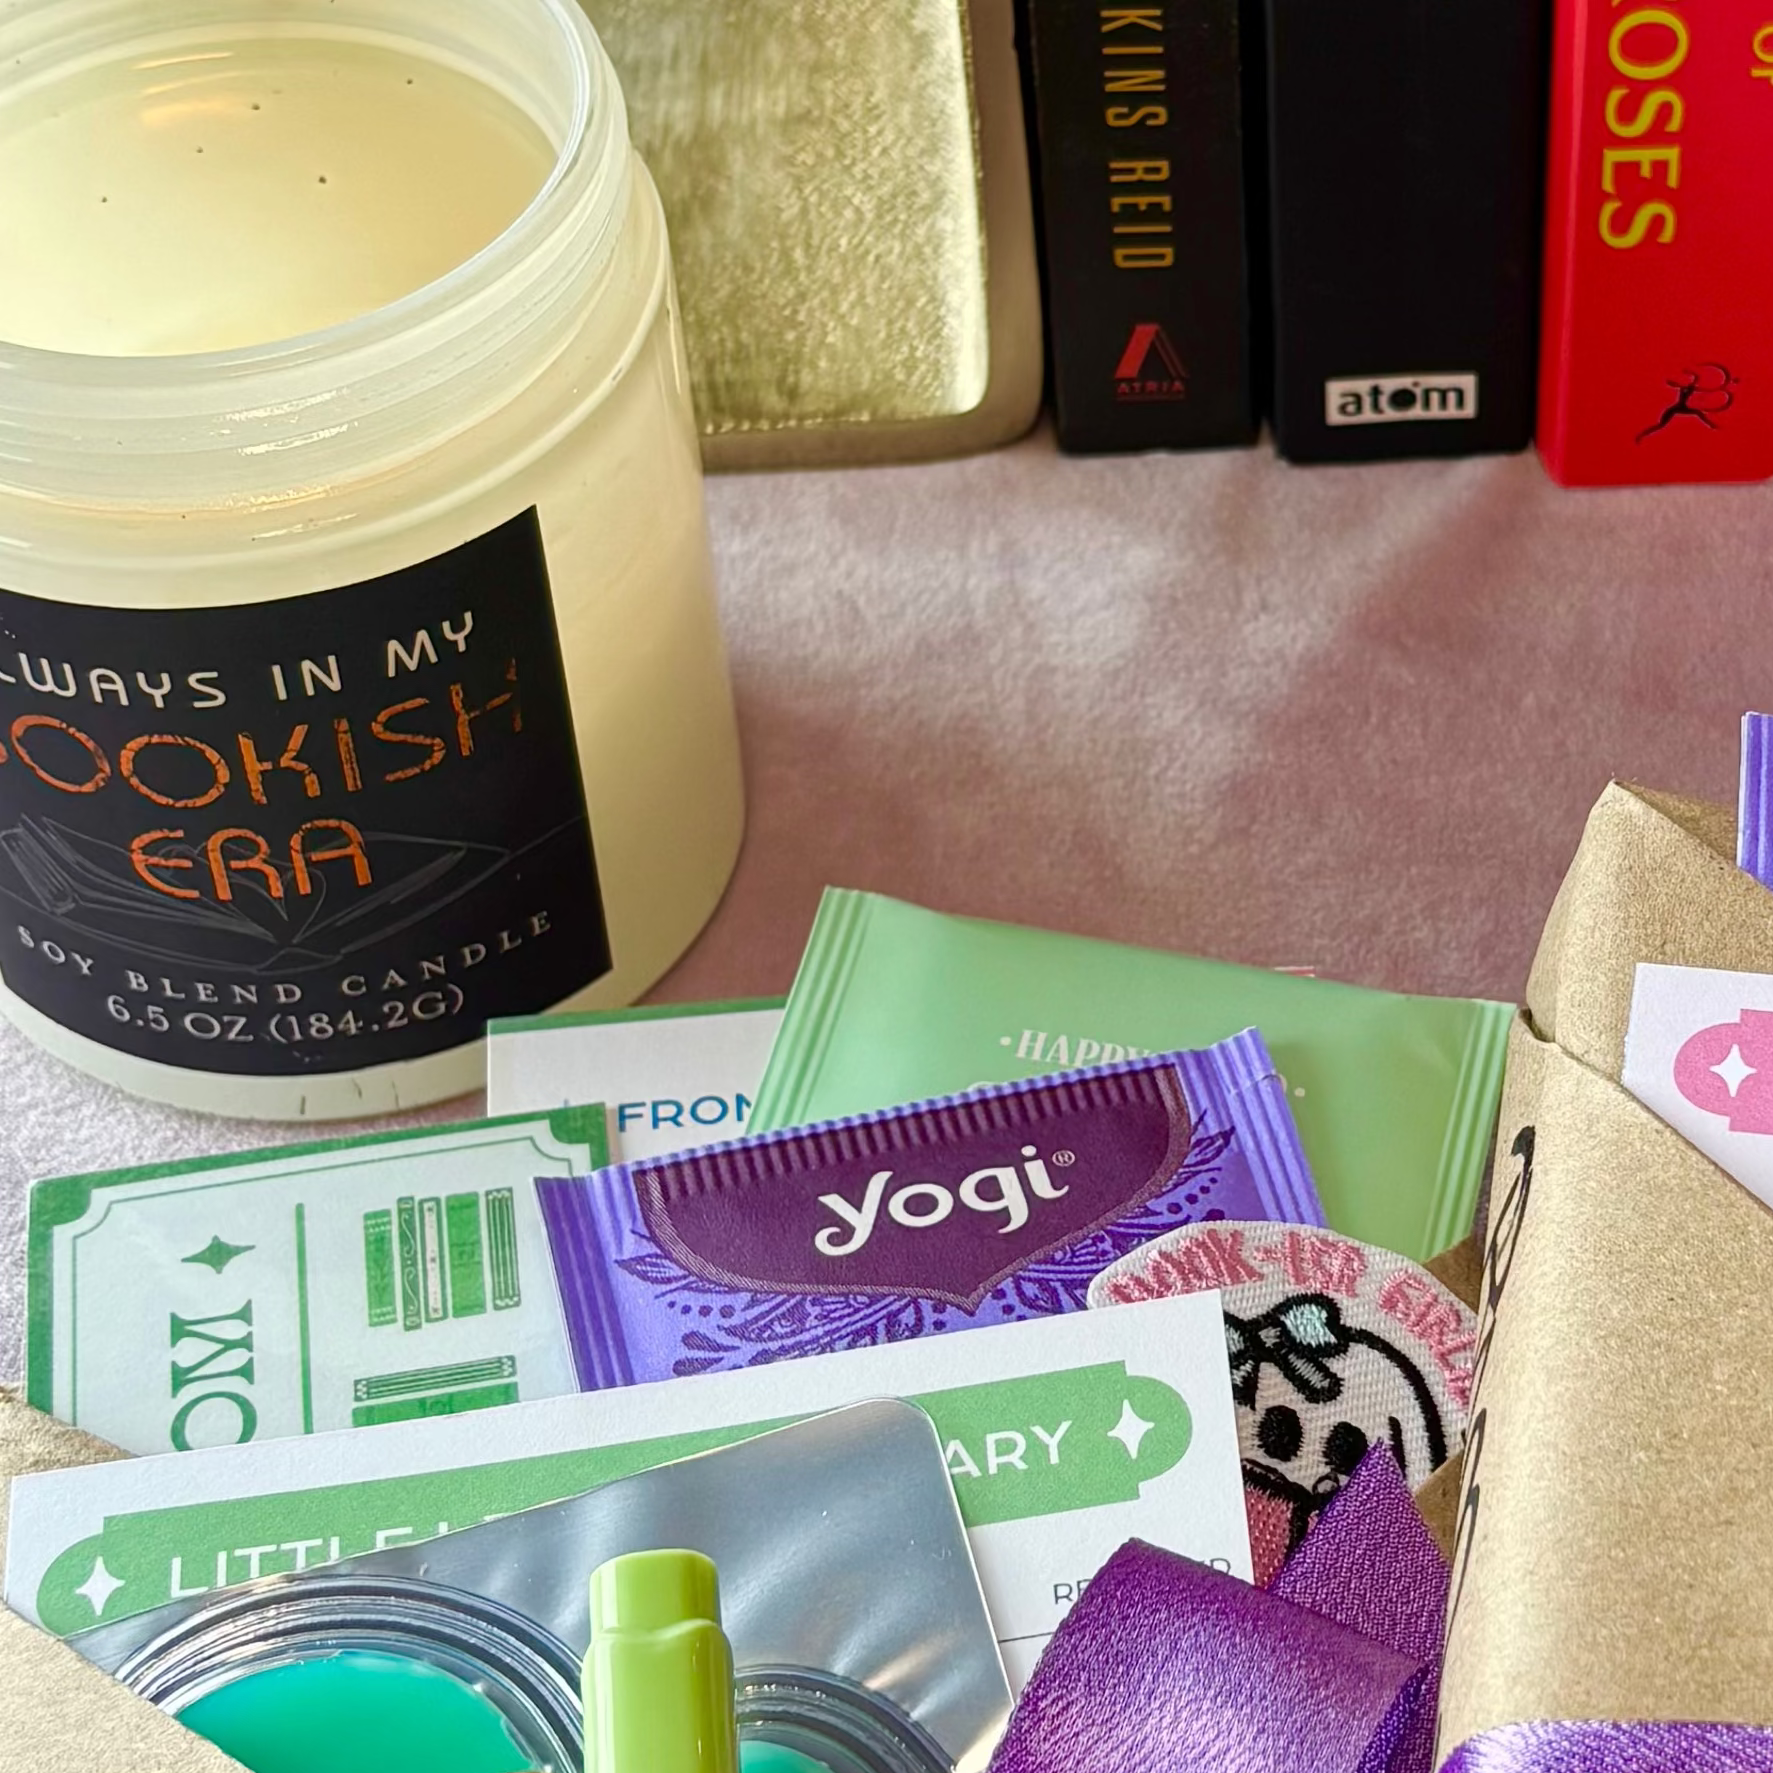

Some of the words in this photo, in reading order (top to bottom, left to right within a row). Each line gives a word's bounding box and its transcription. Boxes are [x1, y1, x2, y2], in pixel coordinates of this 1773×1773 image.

[1598, 0, 1692, 250] OSES
[1108, 160, 1175, 269] REID
[1337, 380, 1467, 417] atom
[272, 653, 343, 702] IN
[386, 610, 475, 678] MY
[0, 657, 521, 809] OOKISH
[129, 818, 373, 902] ERA
[17, 925, 95, 976] SOY
[125, 968, 303, 1005] BLEND
[340, 910, 552, 998] CANDLE
[106, 994, 170, 1033] 6.5
[184, 1011, 255, 1044] OZ
[269, 986, 466, 1045] (184.2G)
